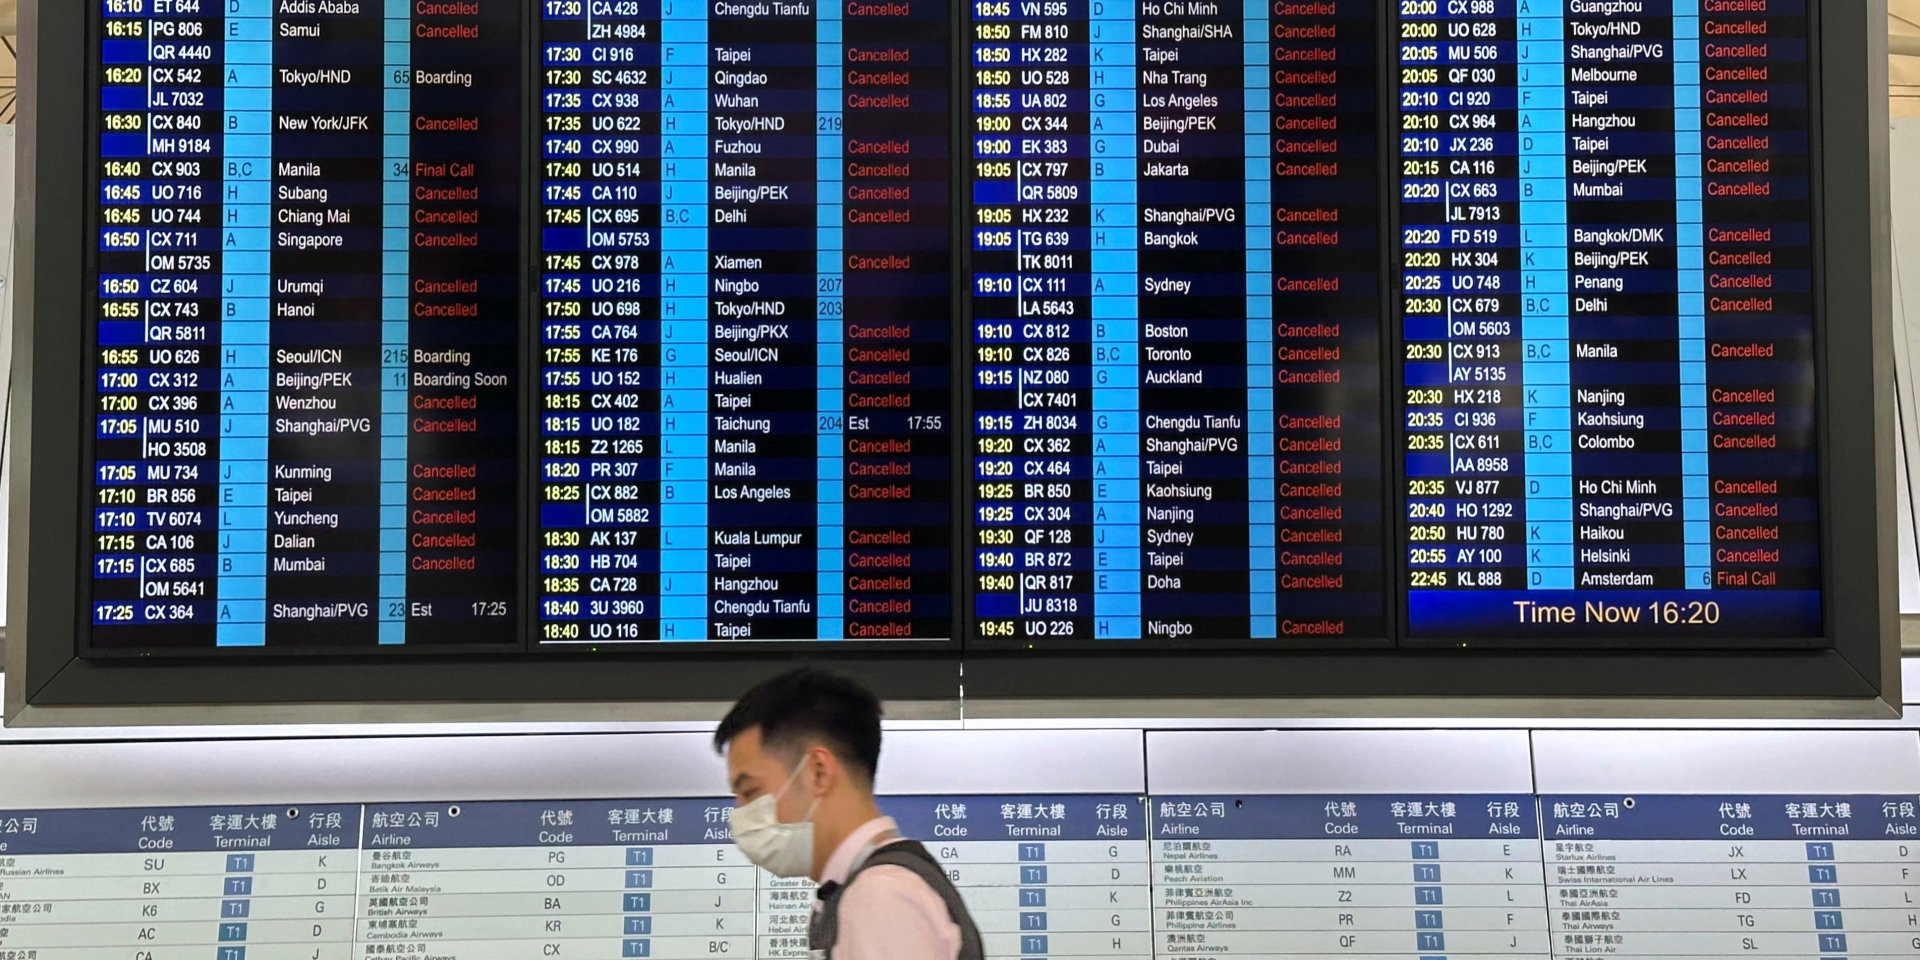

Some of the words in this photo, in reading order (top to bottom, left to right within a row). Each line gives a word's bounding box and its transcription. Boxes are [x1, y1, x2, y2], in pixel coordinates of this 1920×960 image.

[105, 69, 141, 83] 16:20
[153, 69, 172, 83] CX
[175, 69, 201, 83] 542
[228, 70, 238, 83] A
[279, 70, 351, 86] Tokyo/HND
[393, 71, 410, 84] 65
[416, 71, 472, 86] Boarding
[976, 71, 1010, 85] 18:50
[1021, 71, 1042, 85] UO
[1046, 71, 1069, 85] 528
[1095, 72, 1104, 84] H
[1143, 71, 1169, 85] Nha
[1174, 71, 1206, 87] Trang
[1275, 71, 1336, 84] Cancelled
[546, 117, 580, 130] 17:35
[592, 117, 612, 131] UO
[615, 117, 640, 130] 622
[666, 117, 675, 130] H
[715, 117, 784, 133] Tokyo/HND
[819, 117, 842, 130] 219
[105, 163, 140, 176] 16:40
[152, 163, 171, 176] CX
[174, 163, 200, 176] 903
[228, 163, 252, 178] B,C
[279, 163, 320, 176] Manila
[393, 163, 408, 176] 34
[416, 163, 445, 176] Final
[450, 163, 474, 176] Call
[1405, 230, 1440, 243] 20:20
[1452, 230, 1470, 243] FD
[1474, 230, 1497, 243] 519
[1525, 230, 1532, 243] L
[1575, 229, 1663, 245] Bangkok/DMK
[1709, 229, 1770, 242] Cancelled
[978, 348, 1012, 361] 19:10
[1024, 348, 1043, 361] CX
[1047, 348, 1070, 361] 826
[1097, 348, 1120, 362] B,C
[1146, 348, 1191, 361] Toronto
[1278, 347, 1339, 361] Cancelled
[101, 374, 137, 387] 17:00
[149, 374, 169, 387] CX
[172, 374, 197, 387] 312
[224, 374, 234, 386] A
[277, 373, 351, 390] Beijing/PEK
[394, 374, 407, 386] 11
[414, 373, 470, 389] Boarding
[474, 373, 506, 386] Soon
[545, 418, 580, 431] 18:15
[591, 418, 612, 431] UO
[617, 418, 640, 431] 182
[666, 417, 675, 430] H
[715, 417, 770, 432] Taichung
[819, 417, 842, 430] 204
[849, 417, 869, 430] Est
[907, 417, 941, 430] 17:55
[544, 532, 579, 546] 18:30
[591, 532, 610, 545] AK
[614, 532, 636, 545] 137
[665, 532, 672, 545] L
[715, 532, 750, 545] Kuala
[754, 532, 801, 548] Lumpur
[849, 531, 910, 544] Cancelled
[1411, 572, 1446, 586] 22:45
[1458, 572, 1474, 586] KL
[1478, 572, 1502, 586] 888
[1532, 572, 1541, 585] D
[1581, 572, 1653, 586] Amsterdam
[1703, 572, 1710, 585] 6
[1717, 571, 1747, 585] Final
[1752, 571, 1775, 585] Call
[97, 606, 133, 620] 17:25
[145, 606, 165, 619] CX
[168, 606, 193, 619] 364
[221, 606, 230, 618] A
[274, 604, 368, 621] Shanghai/PVG
[389, 604, 404, 617] 23
[412, 604, 432, 617] Est
[472, 602, 506, 616] 17:25
[1513, 601, 1575, 623] Time
[1585, 602, 1640, 623] Now
[1649, 601, 1720, 624] 16:20
[935, 804, 966, 820] 代號
[1001, 804, 1065, 819] 客運大樓
[1096, 804, 1128, 820] 行段
[1160, 802, 1225, 817] 航空公司
[1324, 802, 1356, 817] 代號
[1391, 802, 1456, 817] 客運大樓
[1488, 802, 1519, 817] 行段
[1553, 803, 1619, 818] 航空公司
[1719, 802, 1751, 818] 代號
[1785, 802, 1851, 818] 客運大樓
[1882, 802, 1915, 818] 行段
[141, 815, 175, 832] 代號
[210, 814, 277, 831] 客運大樓
[309, 812, 341, 829] 行段
[372, 812, 439, 828] 航空公司
[541, 810, 573, 826] 代號
[608, 808, 673, 824] 客運大樓
[935, 825, 967, 836] Code
[1006, 824, 1060, 836] Terminal
[1097, 824, 1127, 836] Aisle
[1162, 823, 1199, 834] Airline
[1325, 823, 1358, 834] Code
[1397, 823, 1452, 834] Terminal
[1489, 823, 1520, 834] Aisle
[1556, 824, 1594, 836] Airline
[1720, 824, 1753, 836] Code
[1792, 823, 1848, 836] Terminal
[1886, 823, 1916, 835] Aisle
[138, 837, 173, 849] Code
[214, 836, 270, 848] Terminal
[308, 834, 339, 846] Aisle
[372, 834, 410, 845] Airline
[539, 831, 572, 843] Code
[612, 830, 668, 841] Terminal
[548, 852, 564, 863] PG
[634, 852, 646, 863] T1
[717, 851, 723, 861] E
[941, 847, 958, 859] GA
[1026, 847, 1038, 858] T1
[1109, 846, 1117, 858] G
[1335, 845, 1351, 856] RA
[1419, 845, 1431, 856] T1
[1504, 845, 1510, 856] E
[1729, 846, 1743, 858] JX
[1816, 846, 1828, 858] T1
[1900, 846, 1908, 857] D
[144, 859, 164, 870] SU
[234, 858, 248, 869] T1
[319, 856, 326, 867] K
[1732, 869, 1747, 880] LX
[1817, 869, 1829, 880] T1
[1903, 868, 1909, 879] F
[1339, 914, 1353, 925] PR
[1423, 914, 1435, 925] T1
[1508, 914, 1513, 925] F
[1738, 915, 1754, 927] TG
[1824, 915, 1836, 926] T1
[1909, 915, 1916, 925] H
